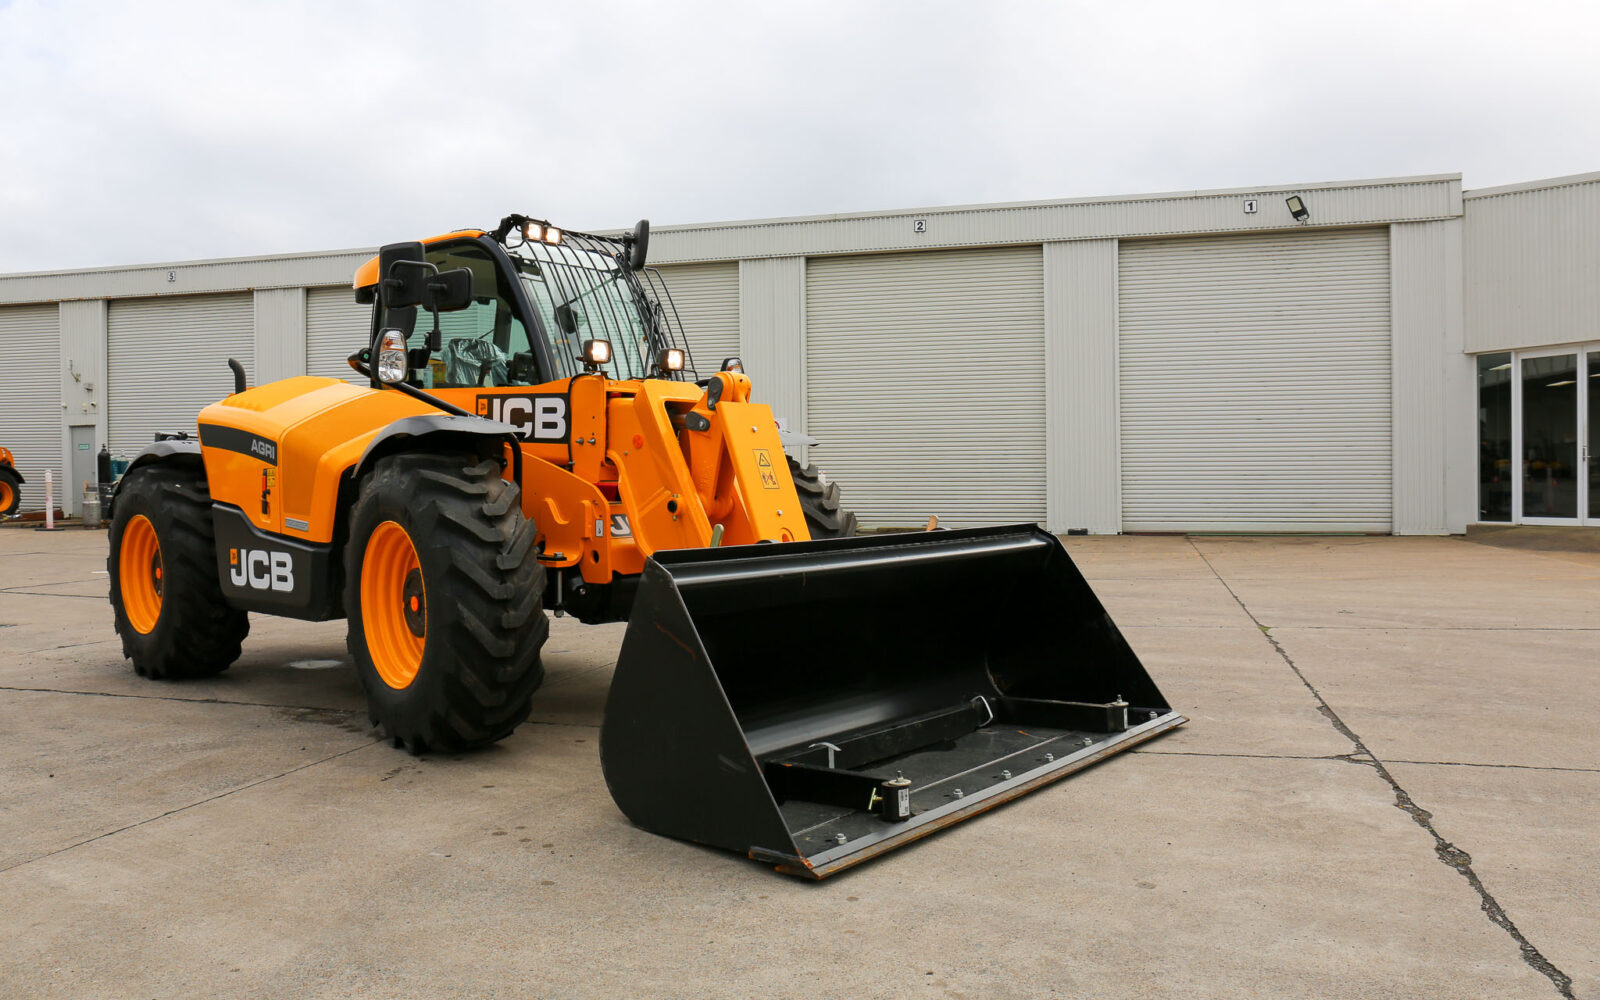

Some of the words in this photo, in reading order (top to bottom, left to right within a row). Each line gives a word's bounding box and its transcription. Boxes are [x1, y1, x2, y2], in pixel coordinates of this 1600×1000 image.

[916, 221, 924, 231] 2
[251, 439, 275, 460] AGRI
[230, 548, 294, 592] JCB
